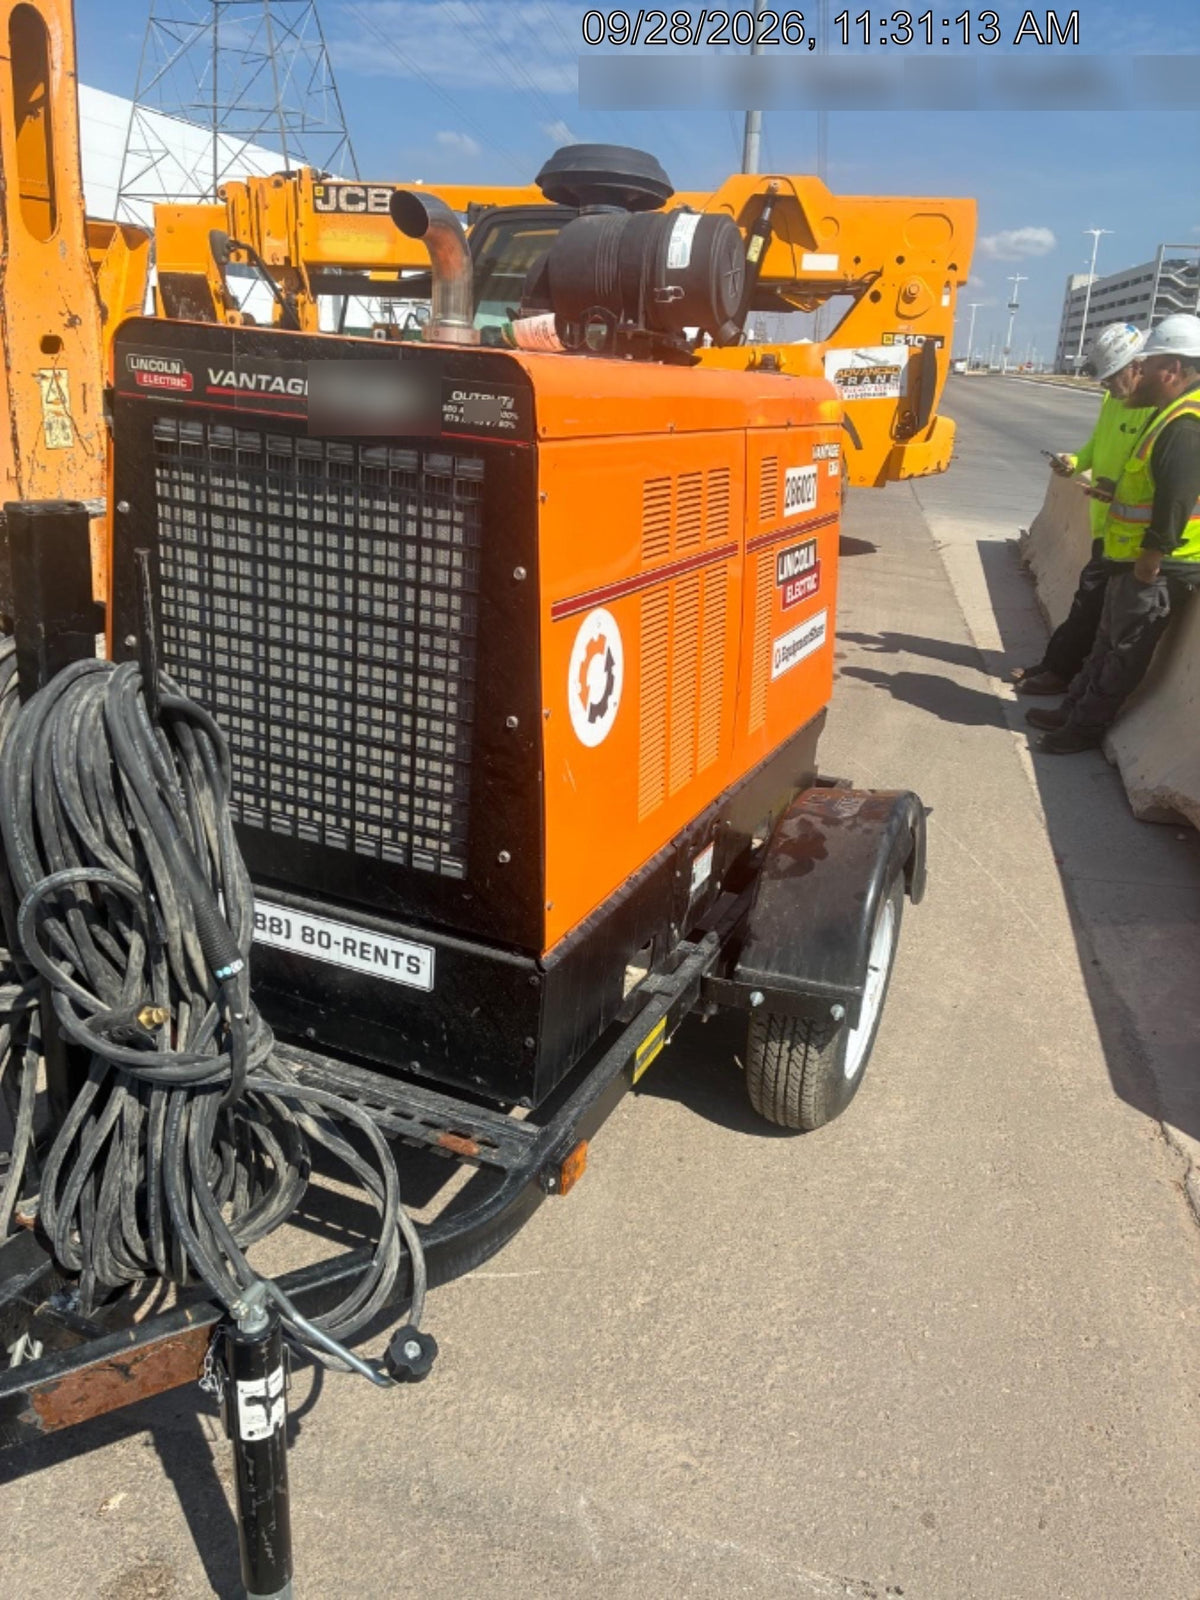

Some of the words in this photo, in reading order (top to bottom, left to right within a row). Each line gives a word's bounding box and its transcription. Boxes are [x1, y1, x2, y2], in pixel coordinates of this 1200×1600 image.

[315, 186, 394, 213] JCB
[130, 357, 181, 374] LINCOLN
[142, 374, 188, 388] ELECTRIC
[207, 368, 309, 396] VANTAG
[835, 374, 900, 386] CRANE
[778, 543, 816, 581] LINCOLN
[785, 573, 818, 604] ELECTRIC
[254, 911, 292, 940] 88)
[301, 925, 421, 976] 80-RENTS
